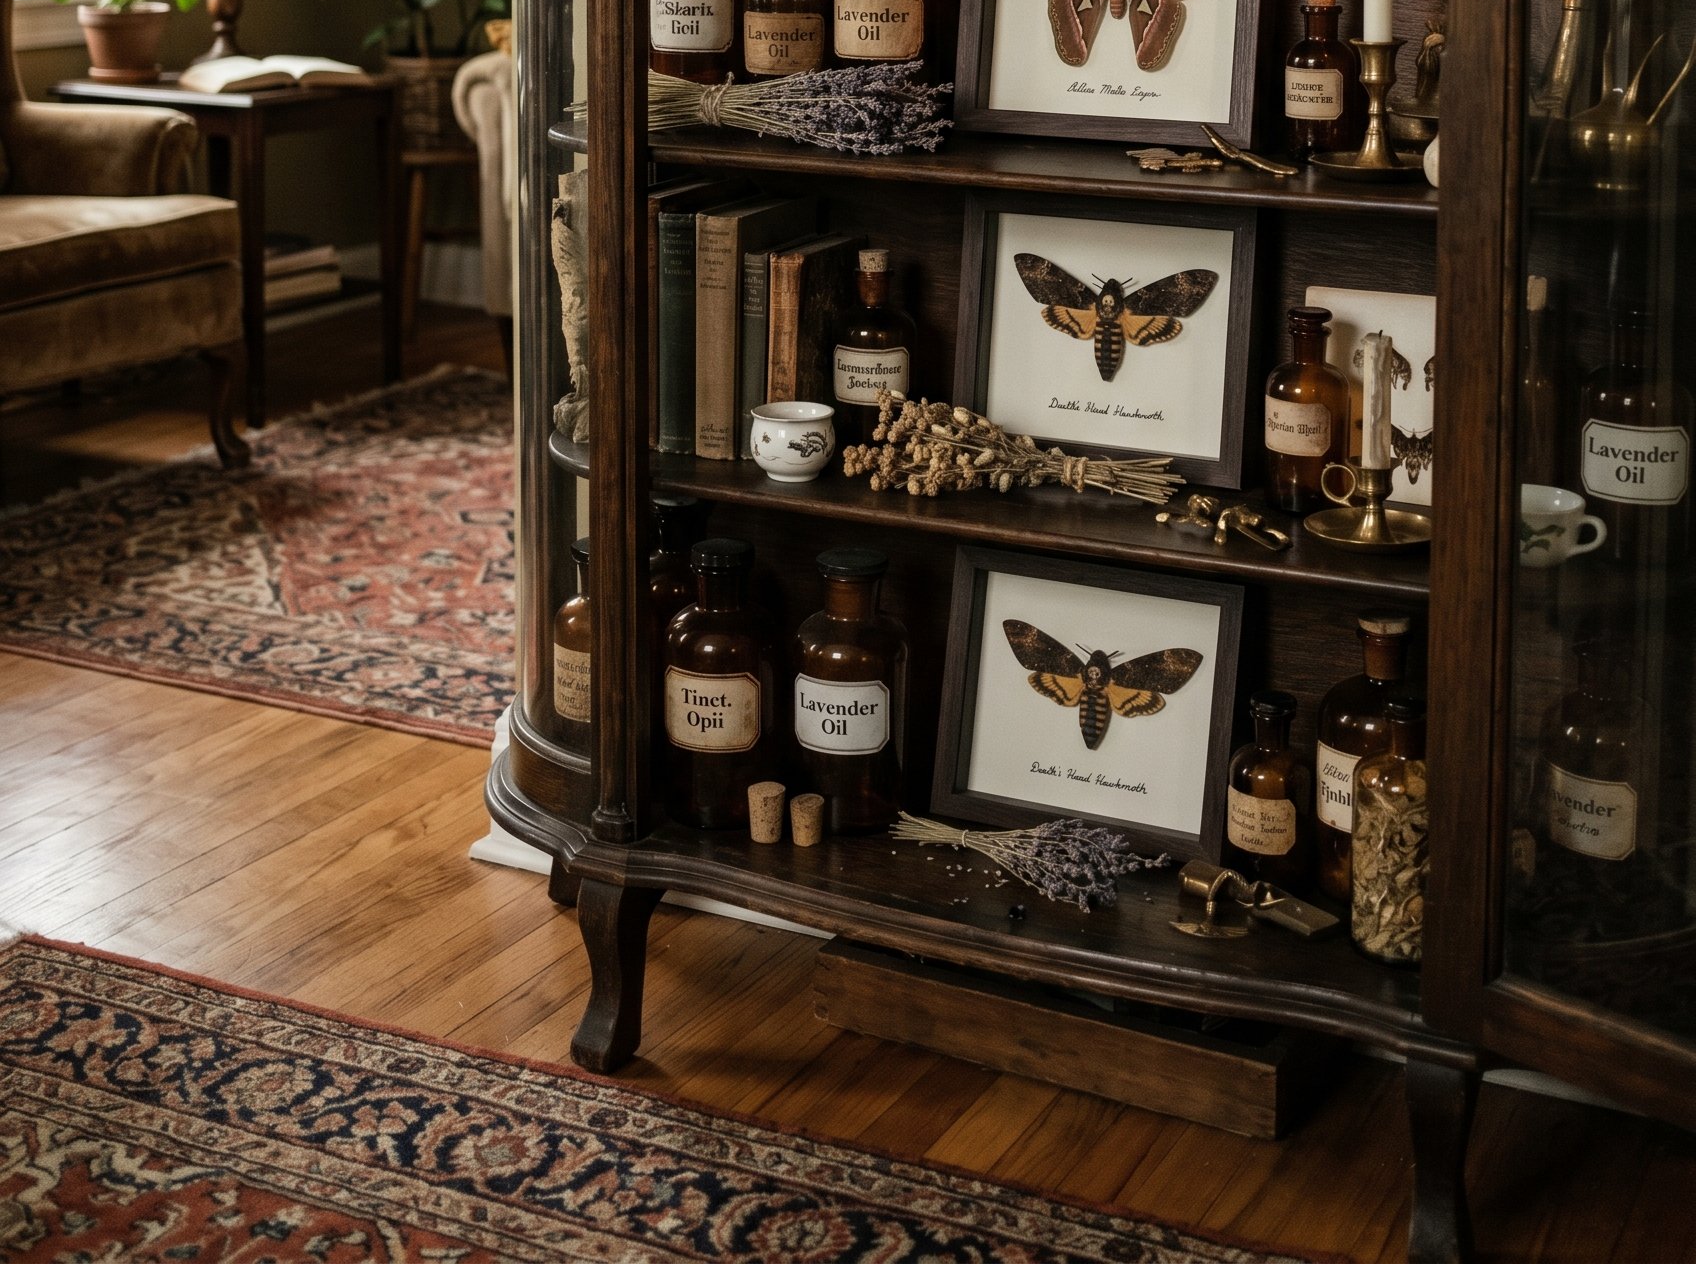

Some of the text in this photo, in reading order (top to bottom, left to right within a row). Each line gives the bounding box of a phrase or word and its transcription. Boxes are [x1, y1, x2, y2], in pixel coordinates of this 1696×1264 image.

[837, 6, 910, 23] Lavender
[748, 26, 816, 42] Lavender
[857, 25, 881, 41] Oil
[768, 43, 789, 58] Oil
[1589, 437, 1679, 463] Lavender
[1615, 466, 1645, 484] Oil
[681, 688, 732, 707] Tinct.
[800, 692, 878, 716] Lavender
[687, 711, 724, 732] Opii
[821, 719, 847, 735] Oil
